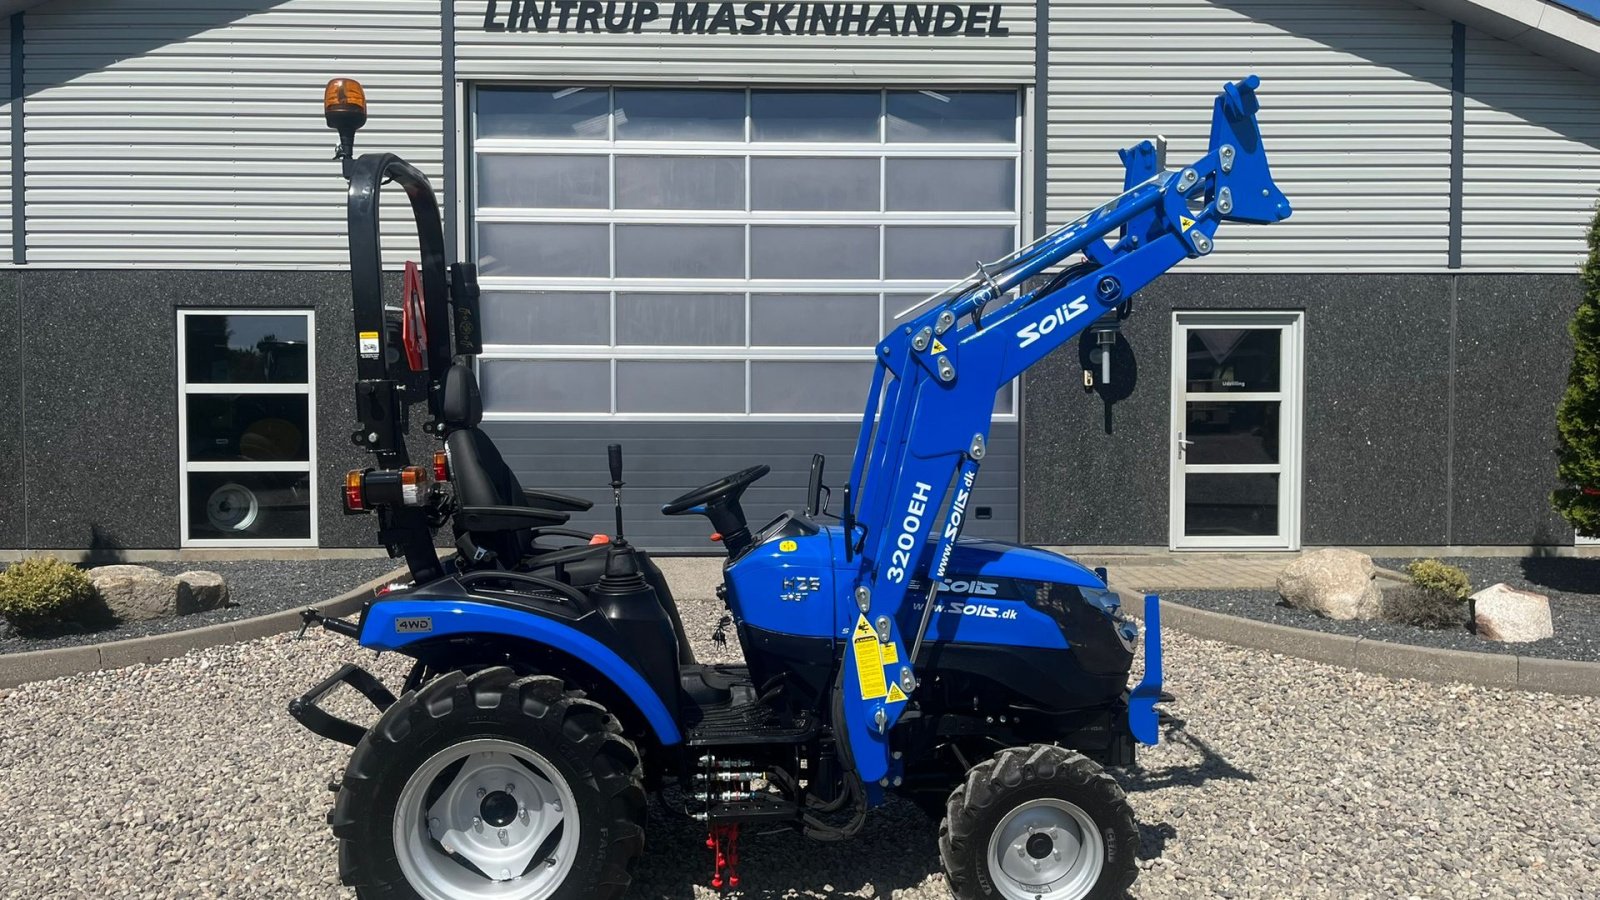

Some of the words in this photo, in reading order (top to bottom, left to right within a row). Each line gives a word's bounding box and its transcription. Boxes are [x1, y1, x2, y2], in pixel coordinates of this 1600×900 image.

[484, 0, 660, 33] LINTRUP
[669, 1, 1010, 36] MASKINHANDEL
[886, 481, 933, 584] 3200EH
[399, 620, 429, 629] 4WD
